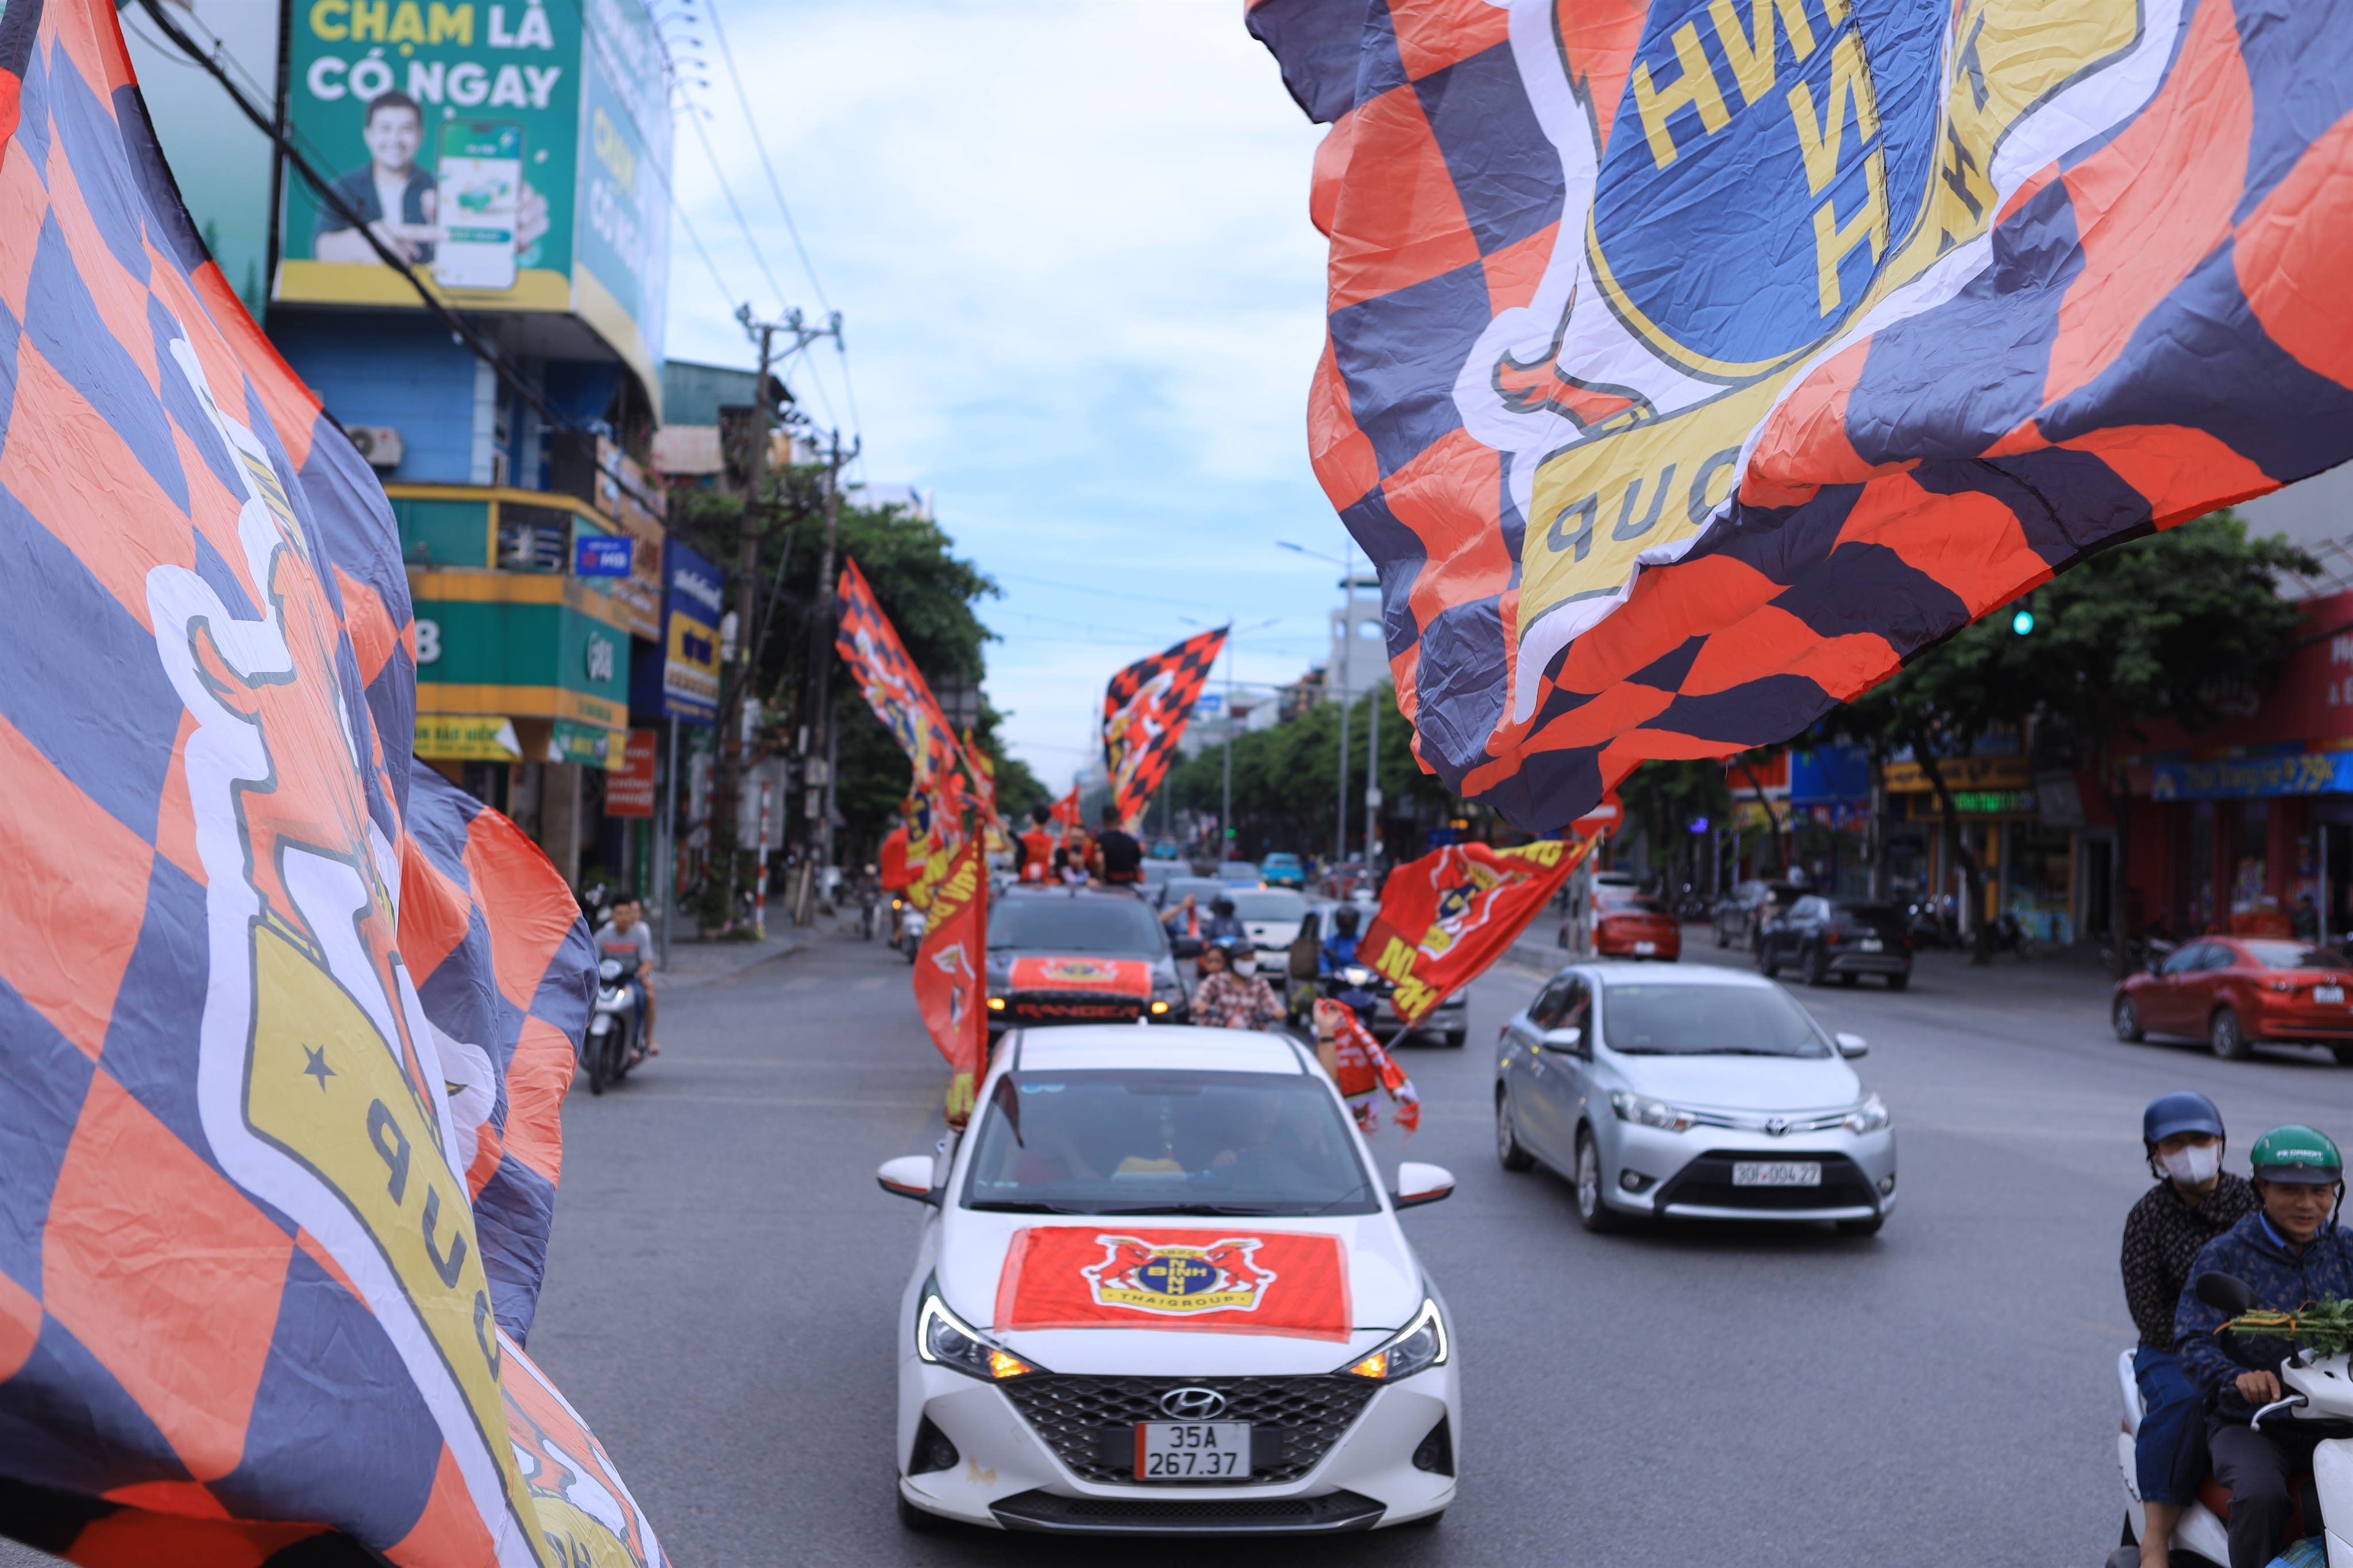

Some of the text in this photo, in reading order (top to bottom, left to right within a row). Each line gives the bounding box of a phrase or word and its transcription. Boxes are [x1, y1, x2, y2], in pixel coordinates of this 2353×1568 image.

[309, 0, 555, 56] CHẠM LÀ
[306, 47, 562, 109] CÓ NGAY
[1120, 1292, 1235, 1307] THAIGROUP
[1170, 1427, 1217, 1448] 35A
[1149, 1453, 1237, 1475] 267.37
